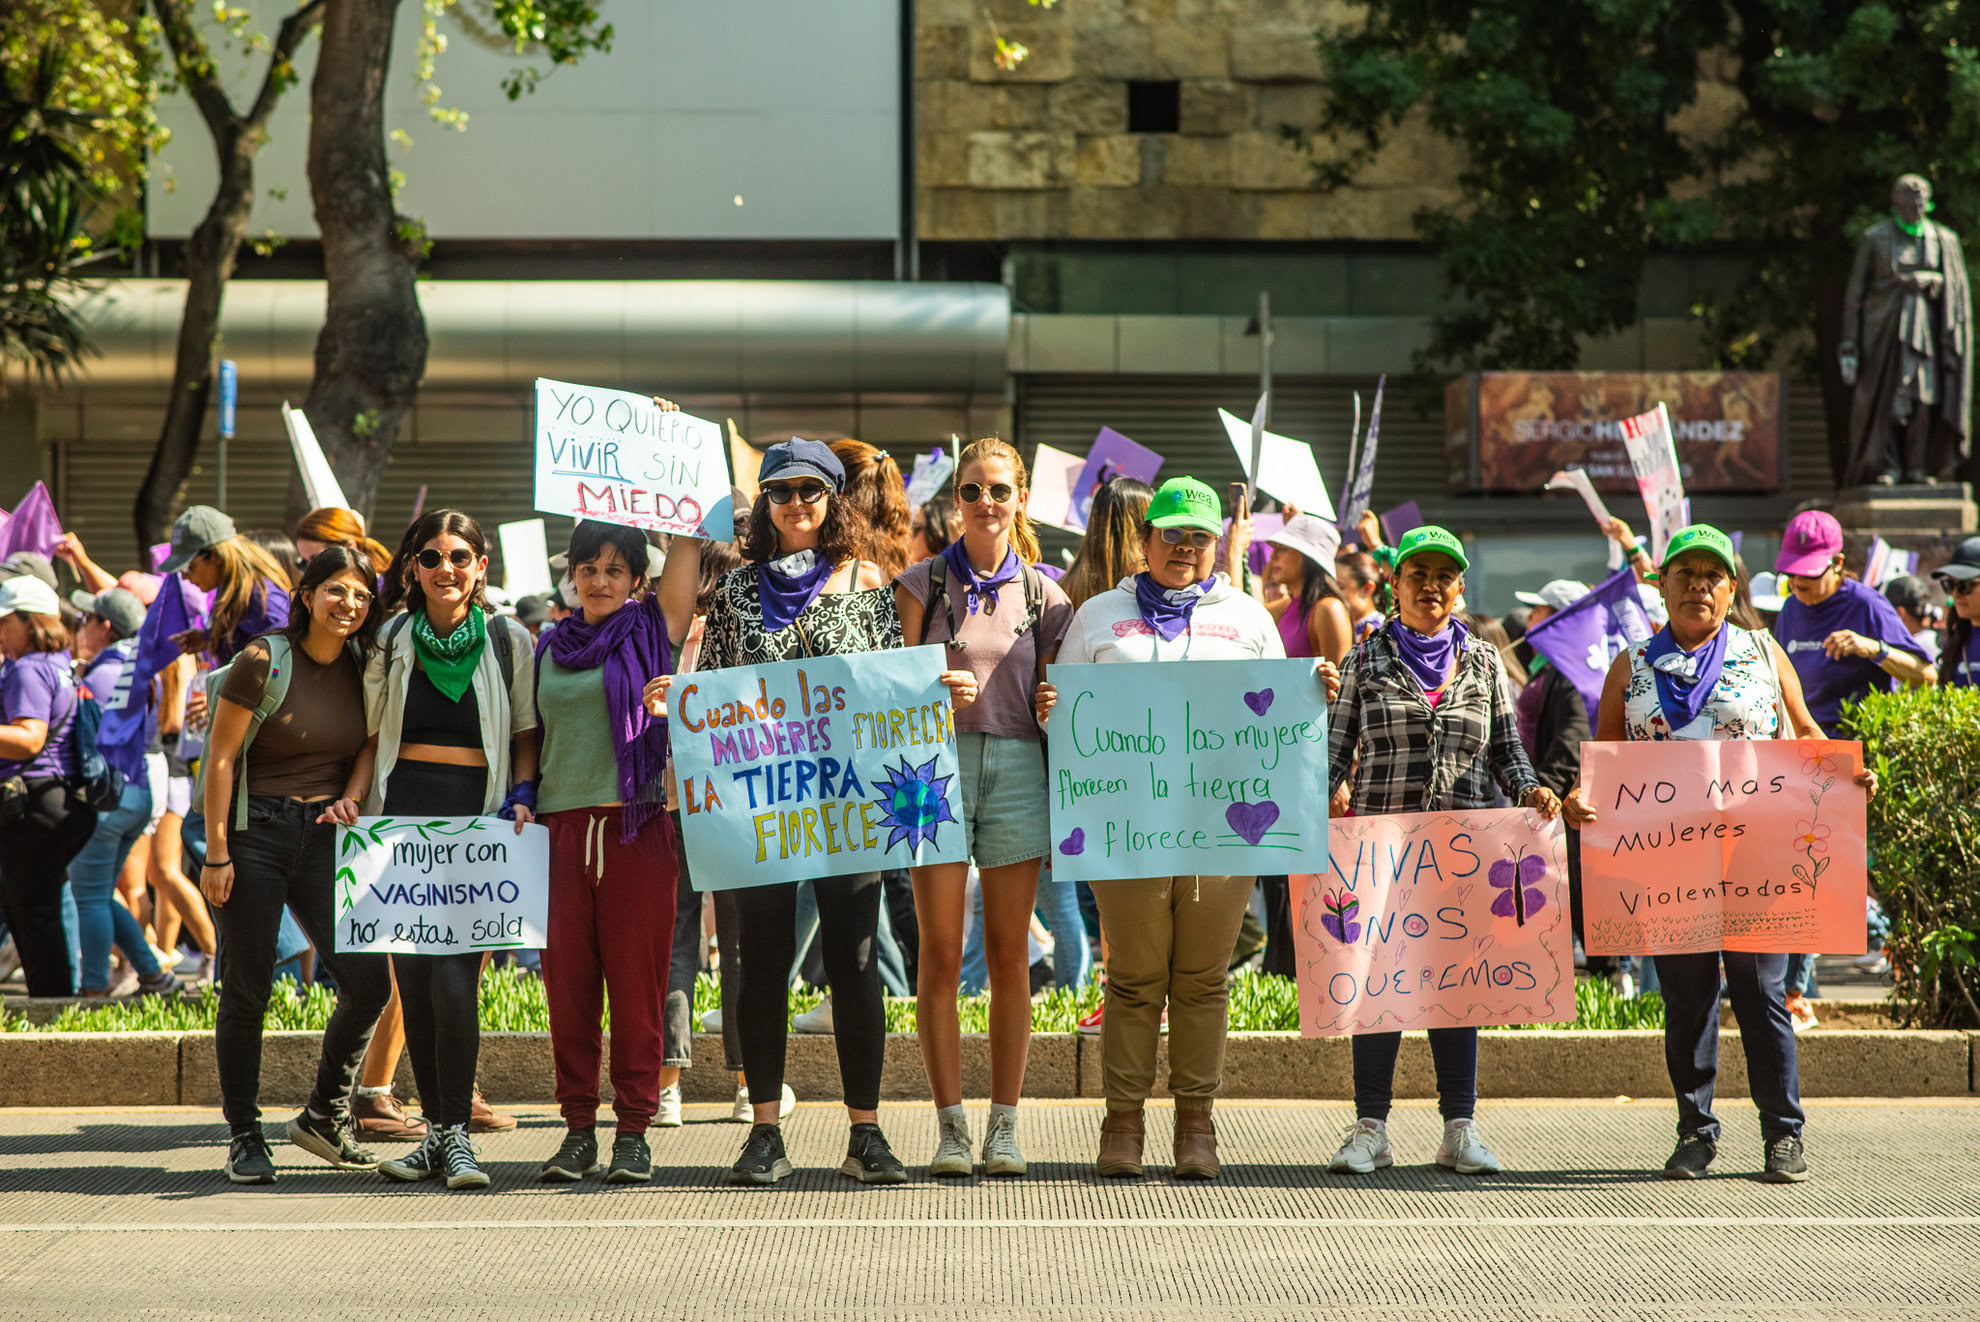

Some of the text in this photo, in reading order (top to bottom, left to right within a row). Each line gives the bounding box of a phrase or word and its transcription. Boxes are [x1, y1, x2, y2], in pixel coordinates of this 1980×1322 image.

[550, 387, 702, 450] YO QUIERO
[678, 668, 847, 733] Cuando las
[709, 716, 832, 767] MUJERES
[1071, 690, 1323, 771] Cuando las mujeres
[683, 756, 866, 815] LA TIERRA
[1057, 761, 1272, 811] florecen la tierra
[1614, 780, 1677, 811] NO
[391, 840, 508, 874] mujer con
[1104, 819, 1213, 858] florece
[1328, 832, 1481, 892] VIVAS
[369, 879, 520, 907] VAGINISMO
[346, 911, 524, 946] no estas sola
[1364, 906, 1469, 946] NOS
[1328, 958, 1538, 1020] QUEREMOS
